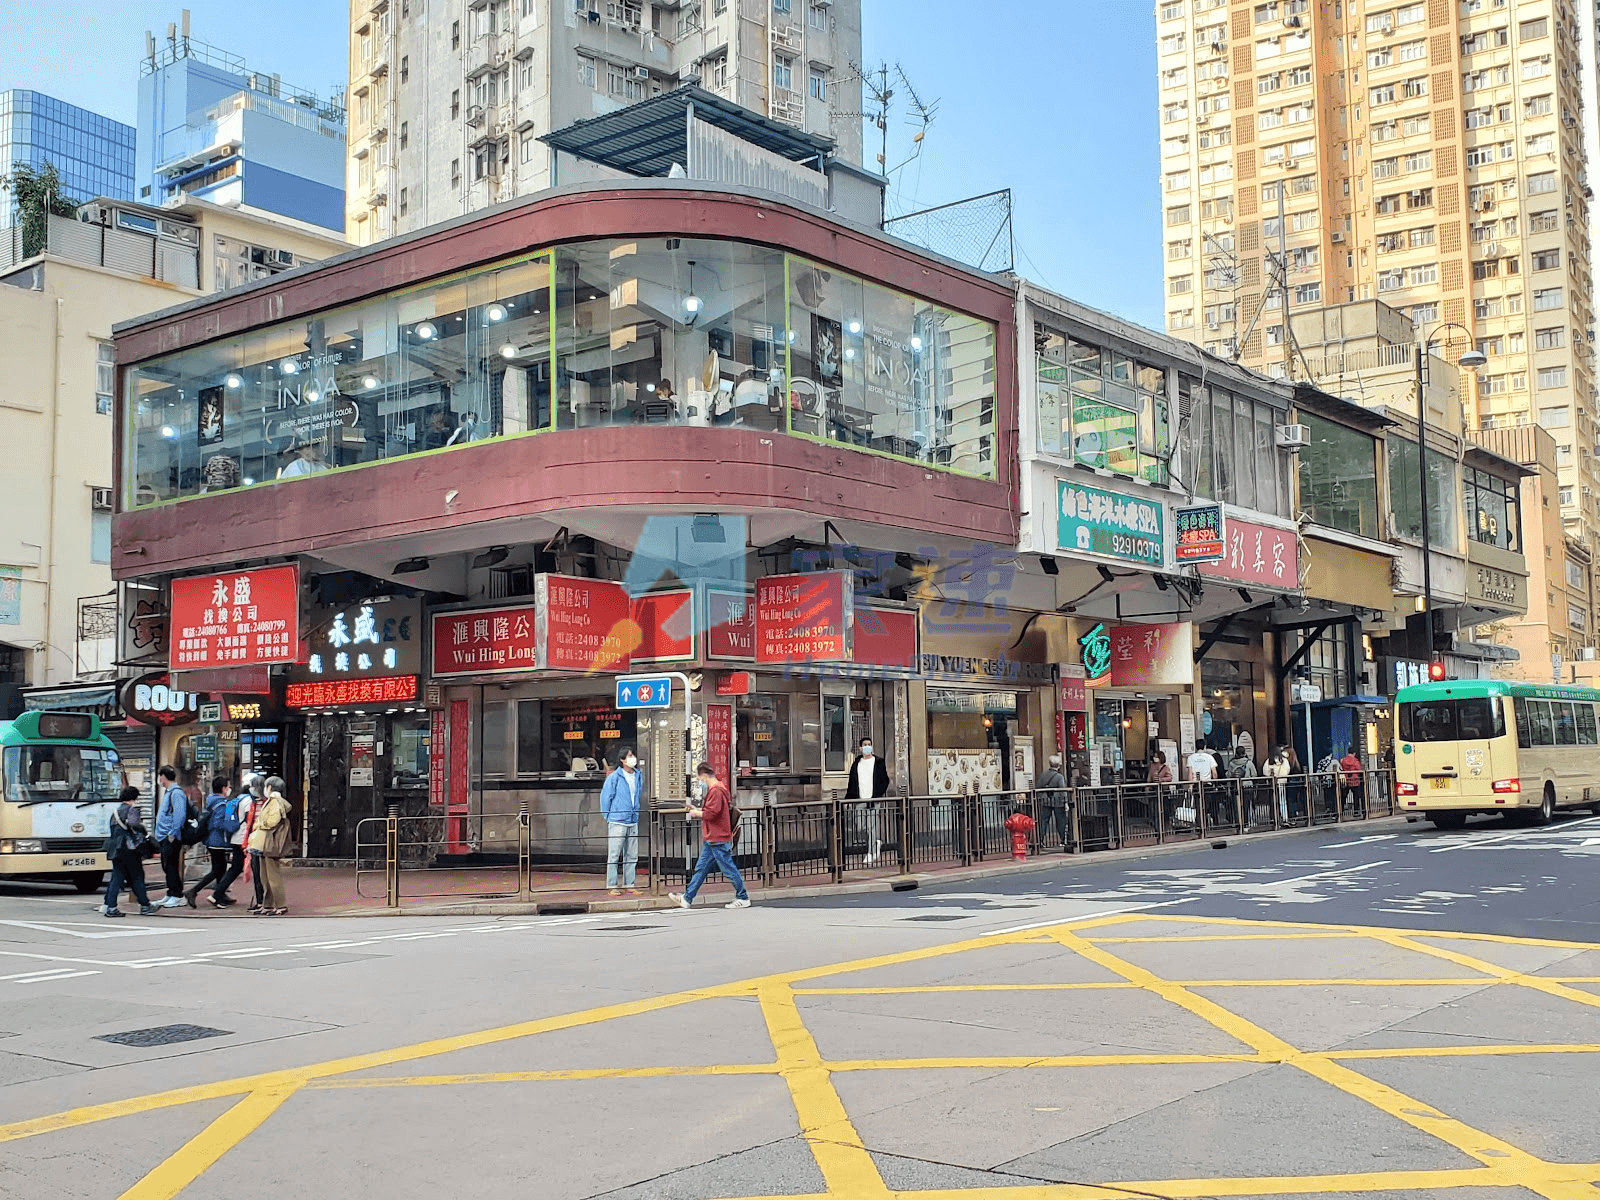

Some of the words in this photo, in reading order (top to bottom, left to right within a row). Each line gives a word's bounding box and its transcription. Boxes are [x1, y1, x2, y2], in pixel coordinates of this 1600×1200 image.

[1112, 535, 1161, 560] 92910379
[1211, 527, 1286, 578] 彩美容
[212, 576, 251, 607] 永盛
[204, 605, 258, 625] 找換公司
[760, 609, 770, 621] Wui
[771, 609, 781, 622] Hing
[781, 608, 793, 622] Long
[328, 606, 380, 648] 永盛
[765, 627, 811, 640] 電話:2408
[811, 625, 835, 637] 3970
[600, 635, 621, 648] 3970
[727, 631, 751, 648] Wui
[765, 641, 811, 655] 傳真:2408
[811, 641, 835, 653] 3972
[452, 650, 476, 665] Wui
[478, 646, 506, 665] Hing
[508, 644, 536, 663] Long
[599, 651, 621, 664] 3972
